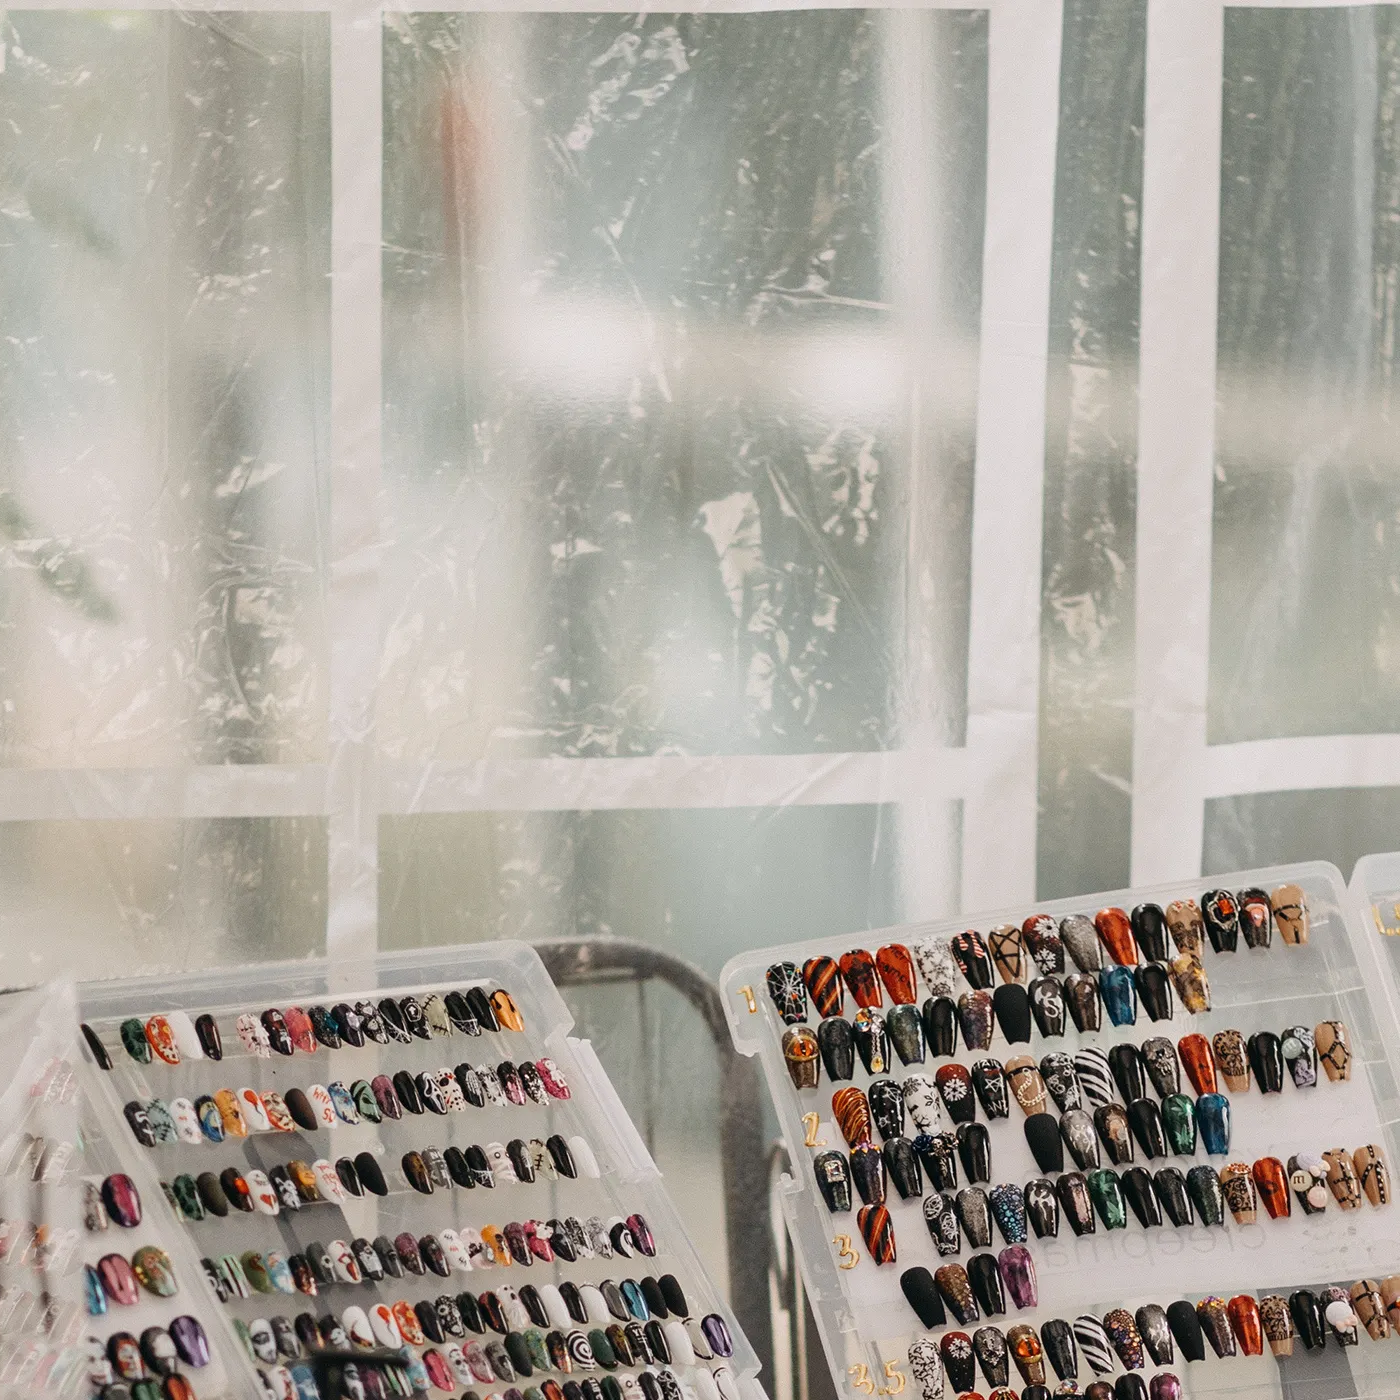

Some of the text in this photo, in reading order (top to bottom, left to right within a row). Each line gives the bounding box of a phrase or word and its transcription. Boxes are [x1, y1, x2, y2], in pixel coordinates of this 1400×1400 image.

[801, 1111, 827, 1148] 2
[832, 1233, 860, 1270] 3
[848, 1358, 907, 1396] 3.5
